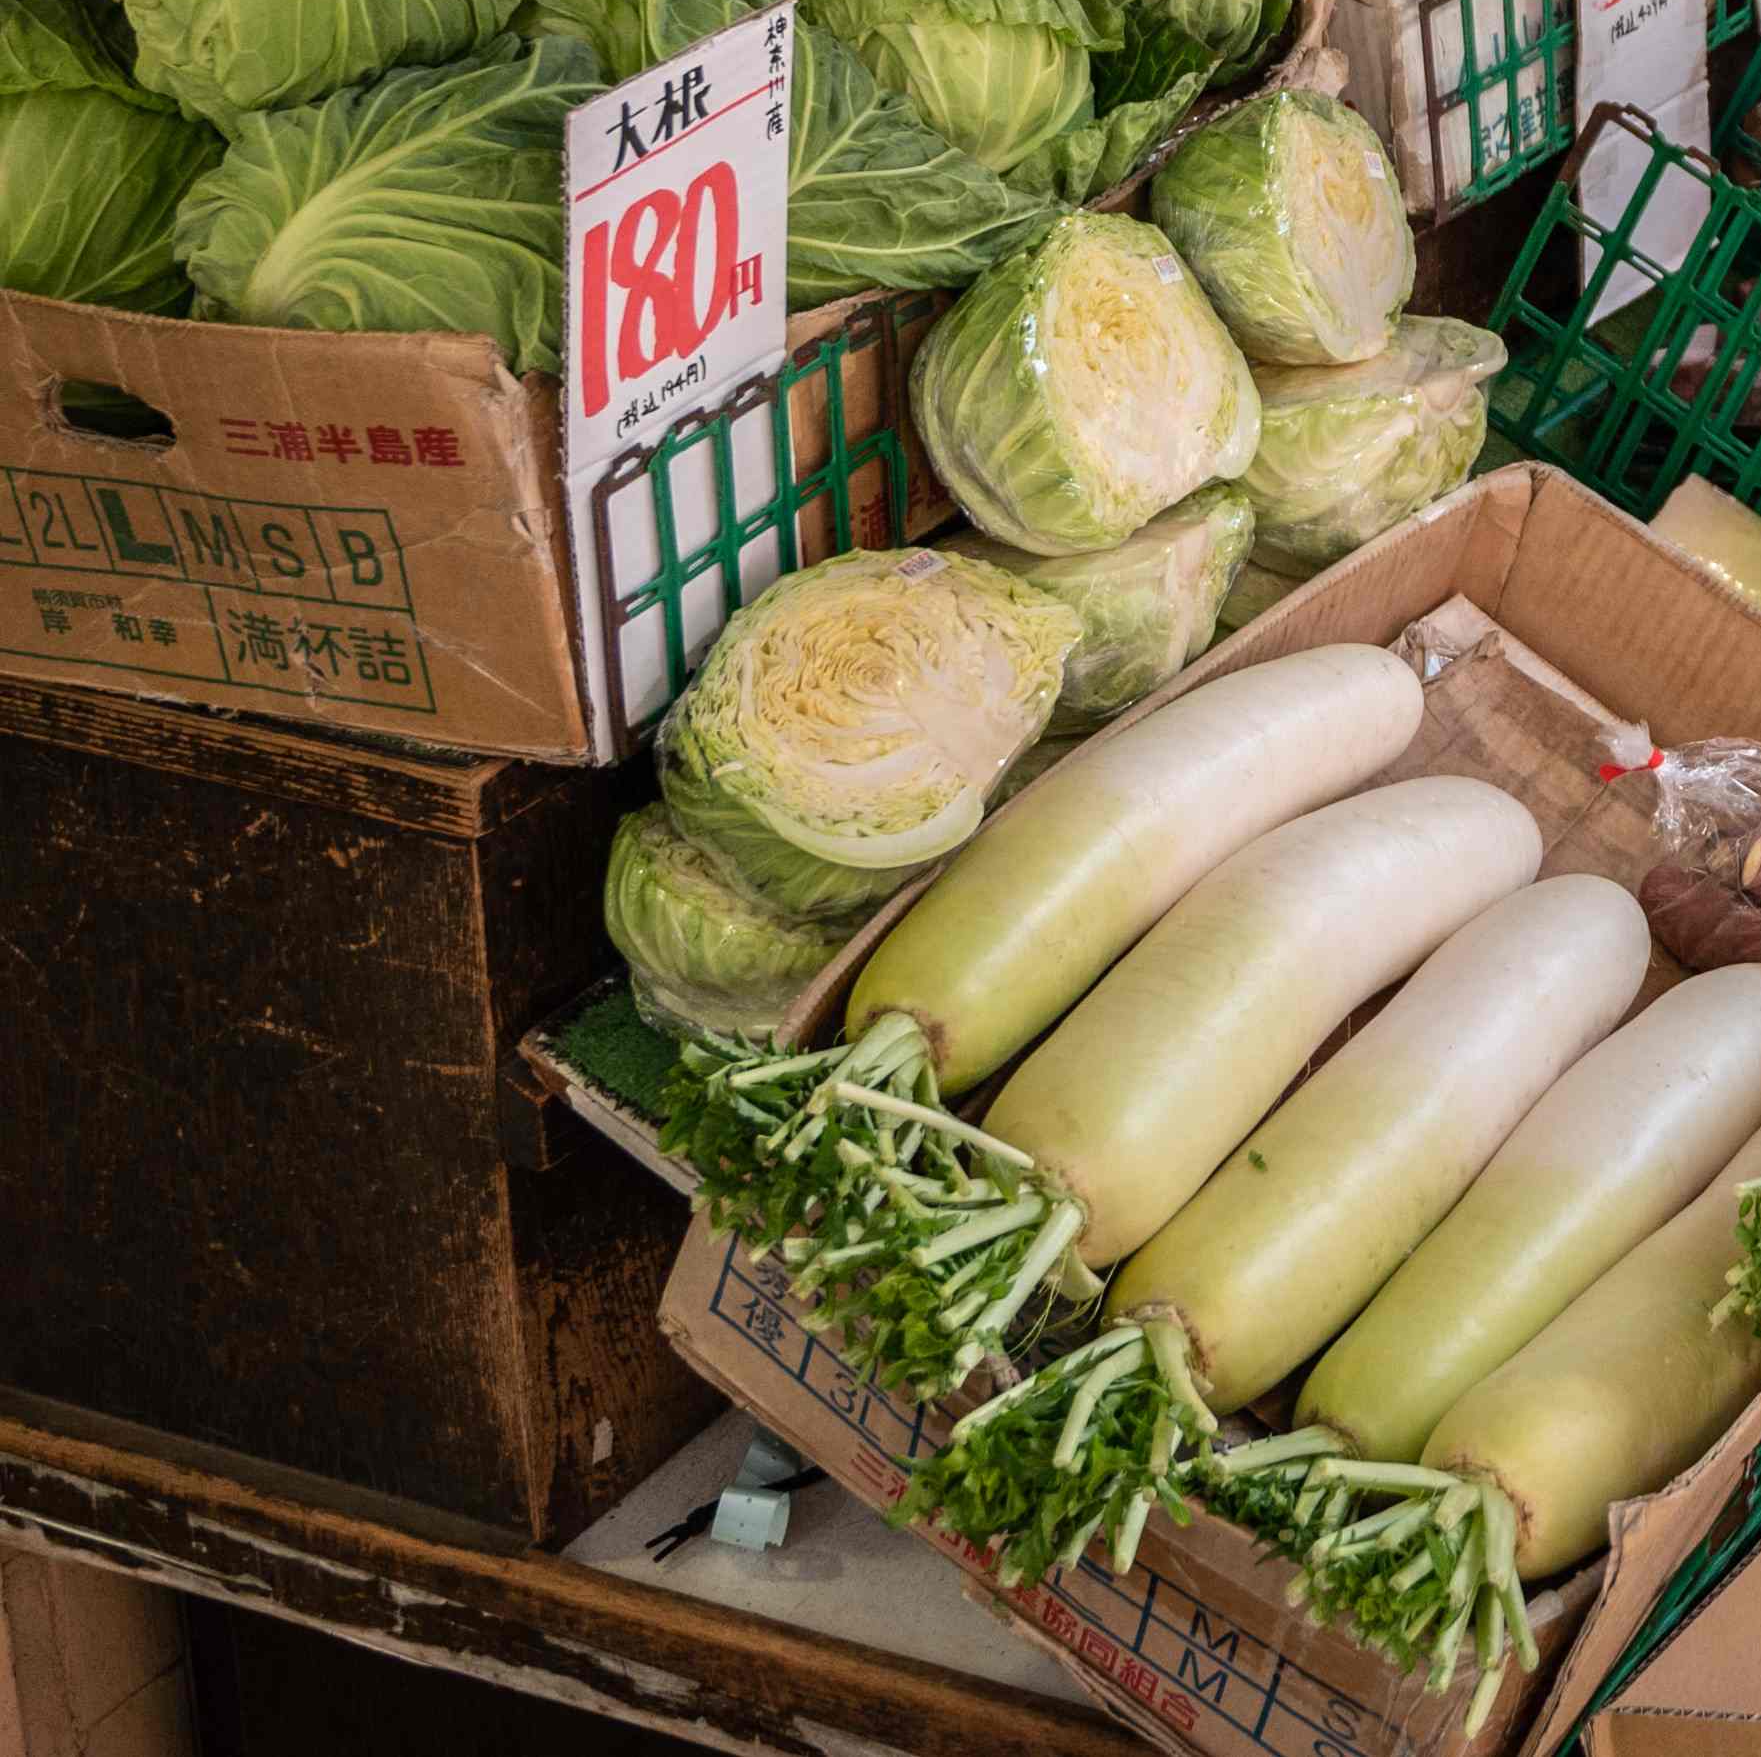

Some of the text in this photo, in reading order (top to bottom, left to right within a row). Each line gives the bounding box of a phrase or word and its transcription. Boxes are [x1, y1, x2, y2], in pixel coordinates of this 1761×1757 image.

[606, 66, 713, 173] 大根
[580, 160, 763, 418] 180円
[219, 417, 467, 469] 三浦半島産
[29, 492, 98, 552] 2L
[95, 488, 176, 566] L
[180, 507, 242, 571] M
[261, 522, 306, 581] S
[339, 528, 385, 588] B
[226, 608, 413, 687] 満杯詰
[1189, 1609, 1240, 1663] M
[1178, 1649, 1229, 1703] M
